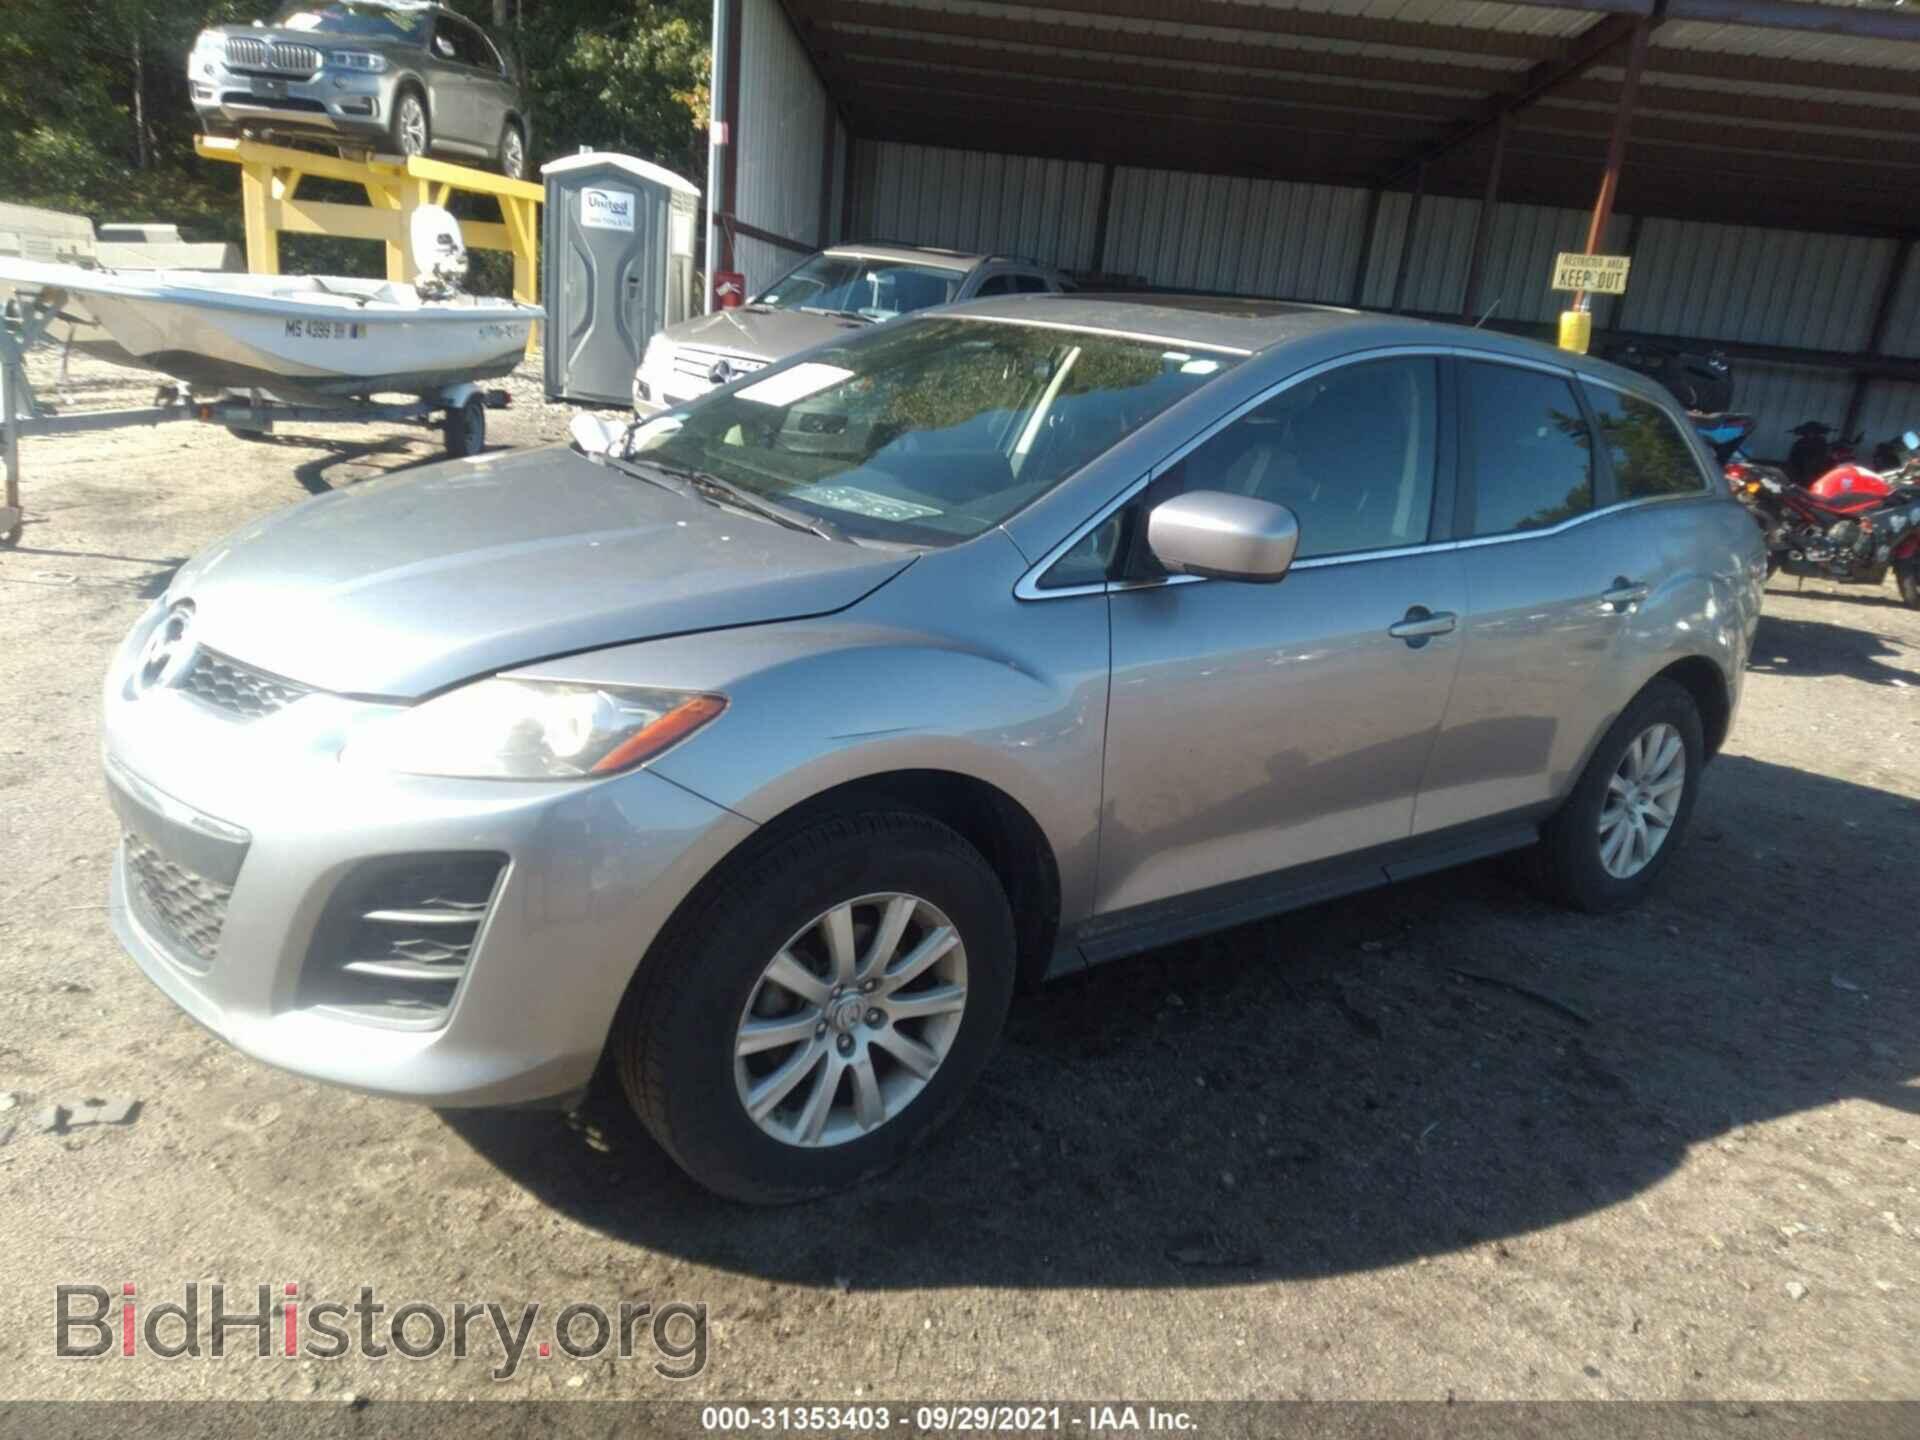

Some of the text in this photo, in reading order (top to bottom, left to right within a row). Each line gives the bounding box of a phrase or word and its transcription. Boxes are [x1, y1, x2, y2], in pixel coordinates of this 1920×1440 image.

[1558, 269, 1624, 289] KEEP OUT
[285, 319, 302, 337] MS
